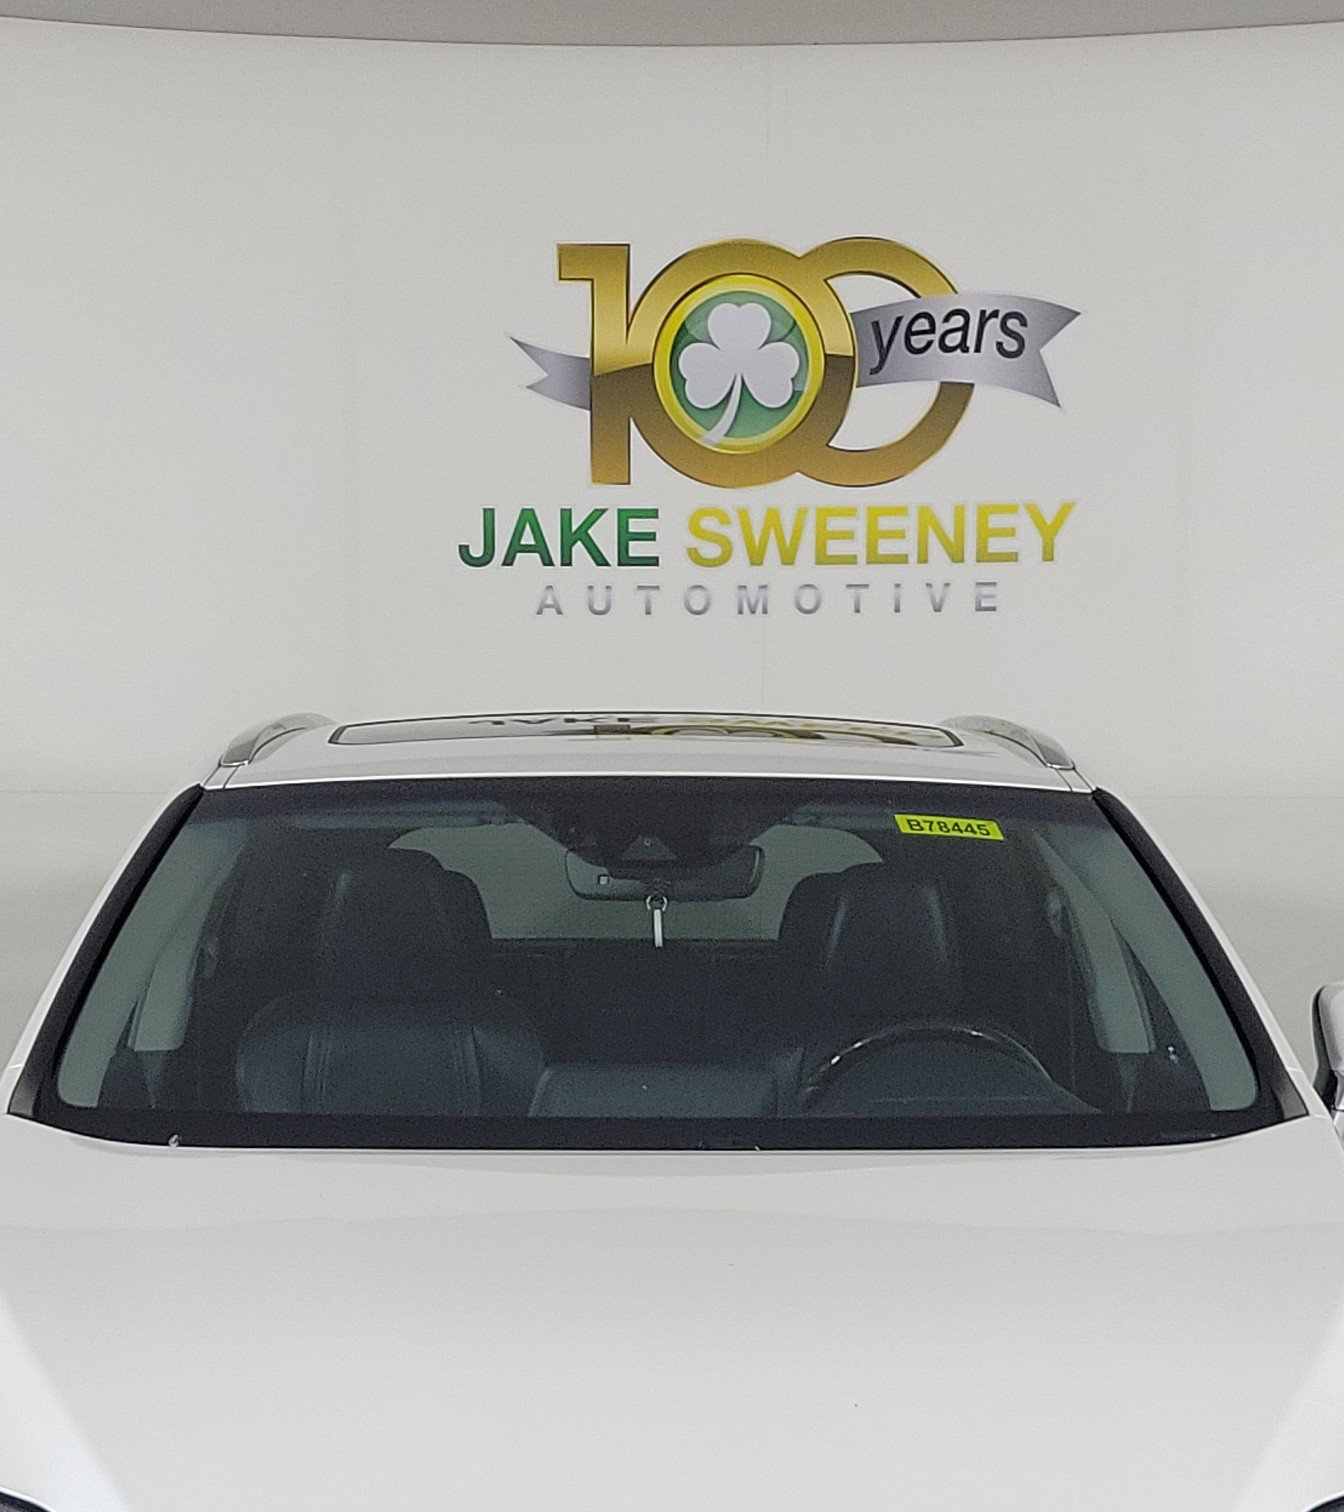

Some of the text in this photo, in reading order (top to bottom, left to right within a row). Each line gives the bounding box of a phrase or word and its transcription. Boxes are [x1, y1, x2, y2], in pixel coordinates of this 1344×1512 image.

[557, 236, 1028, 489] 100 years
[458, 502, 1076, 568] JAKE SWEENEY
[536, 581, 999, 616] AUTOMOTIVE
[905, 818, 991, 836] B78445
